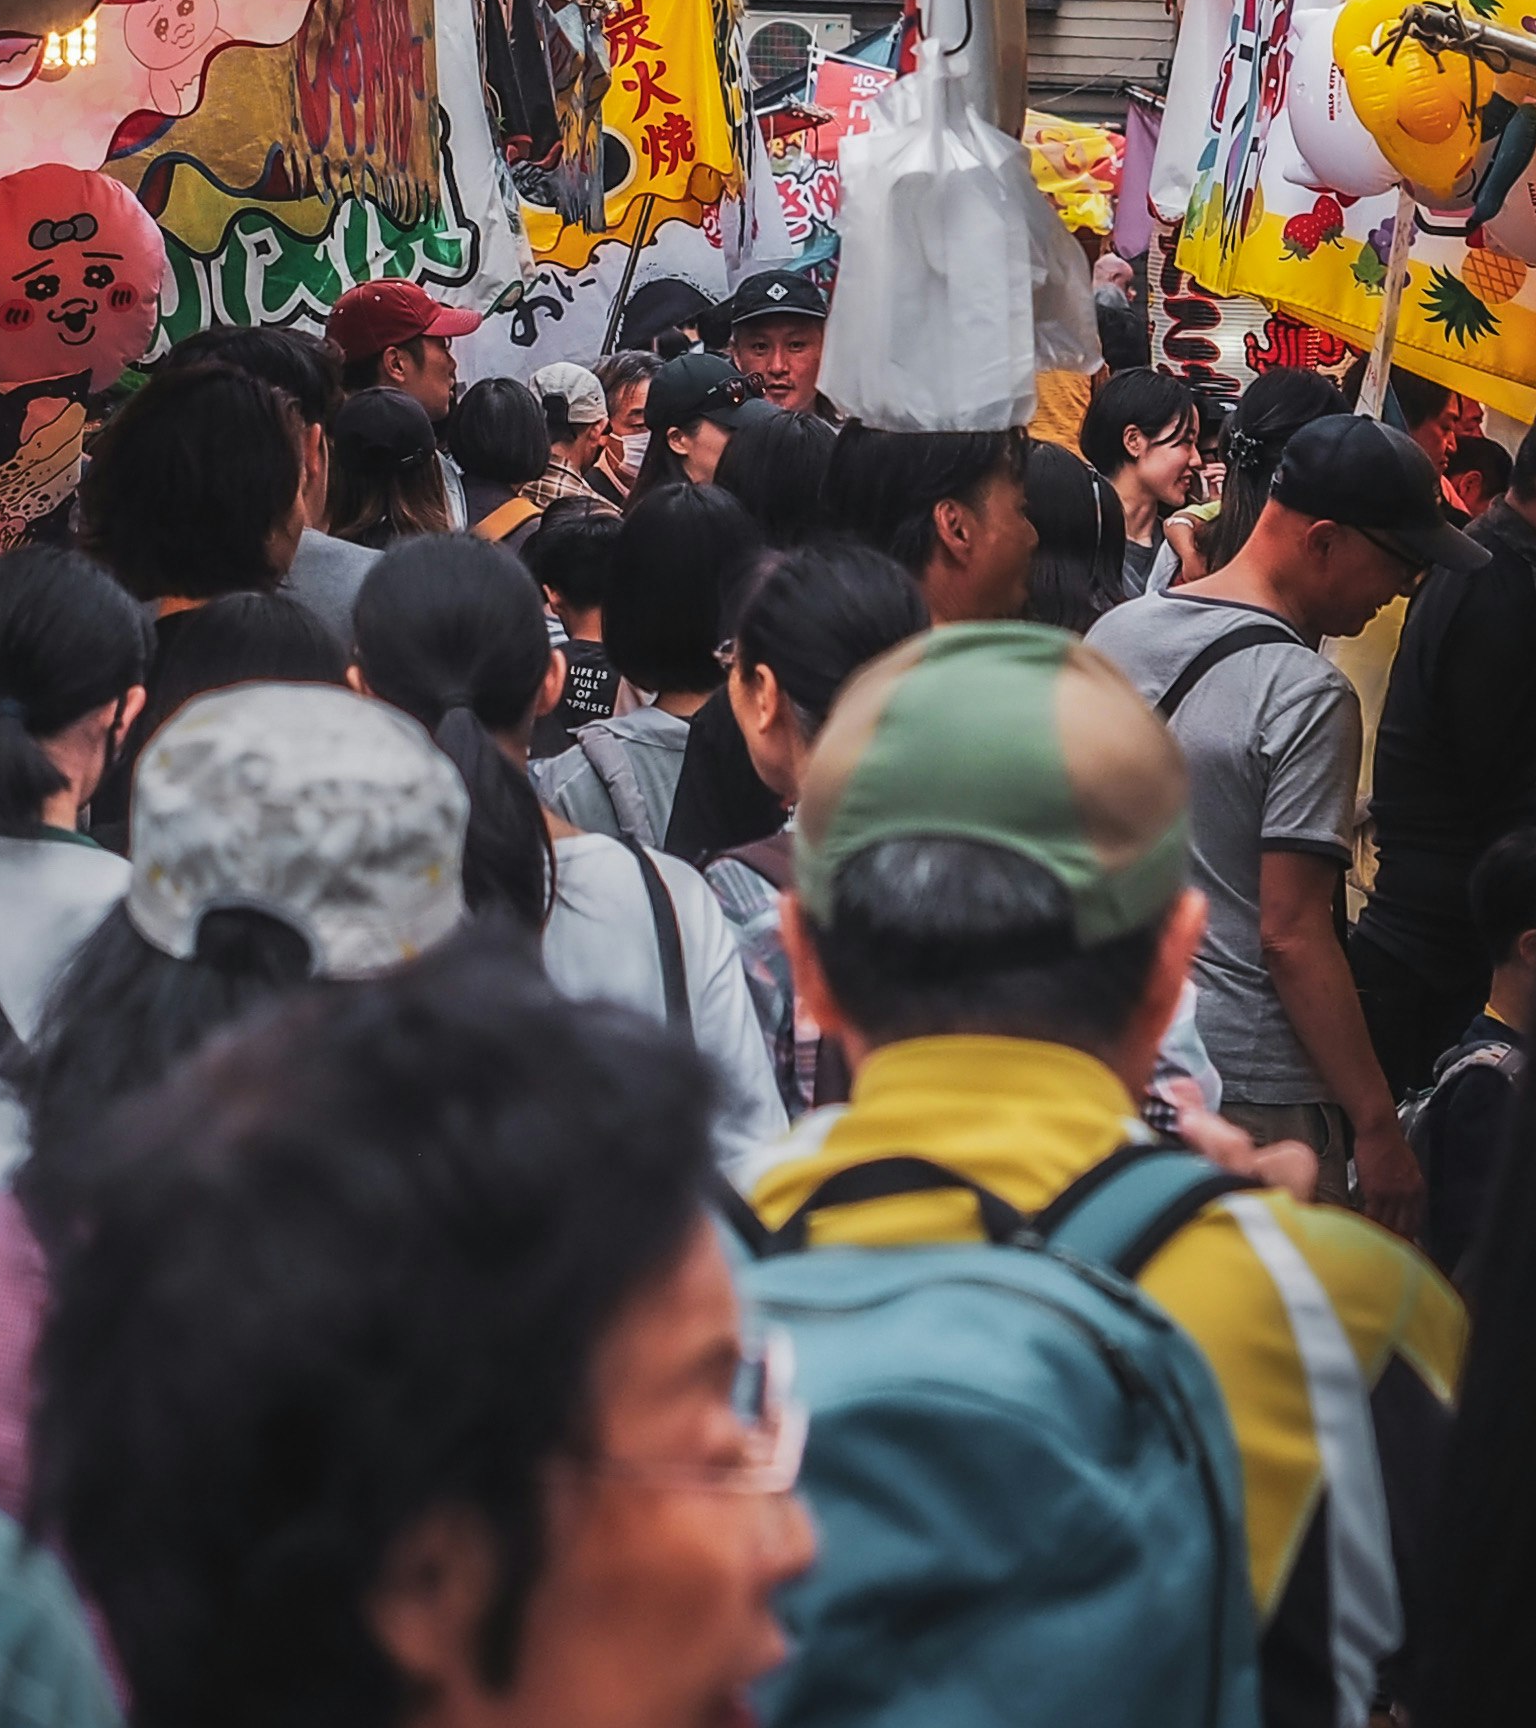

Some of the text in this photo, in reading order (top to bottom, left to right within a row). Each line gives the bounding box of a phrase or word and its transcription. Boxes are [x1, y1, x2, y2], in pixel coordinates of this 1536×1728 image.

[1327, 92, 1336, 121] HELLO
[570, 665, 608, 680] LIFE IS
[573, 677, 599, 690] FULL
[575, 689, 591, 699] OF
